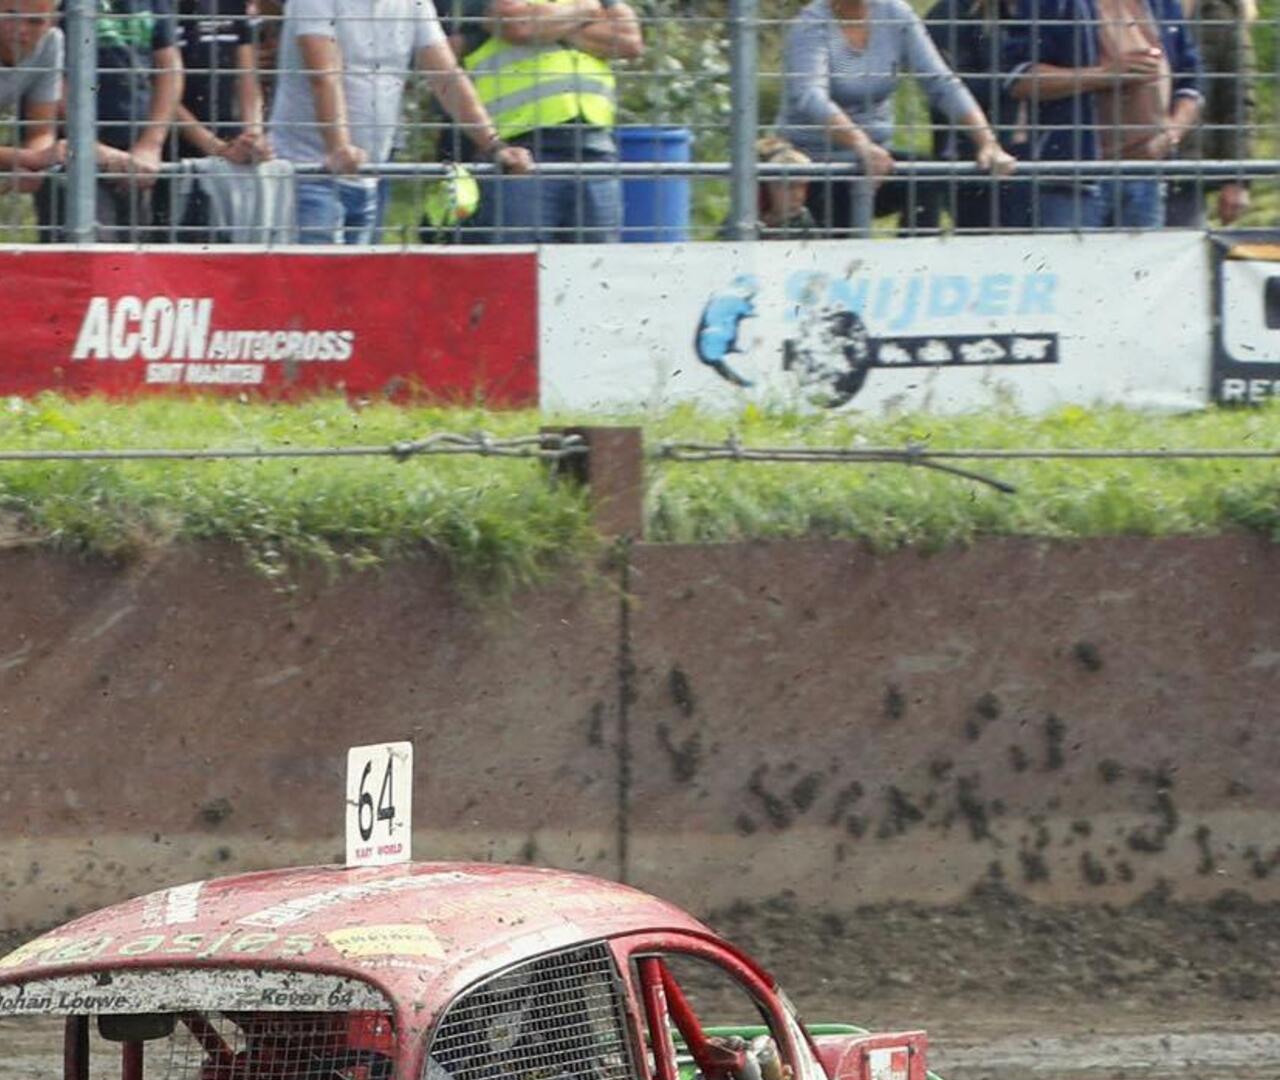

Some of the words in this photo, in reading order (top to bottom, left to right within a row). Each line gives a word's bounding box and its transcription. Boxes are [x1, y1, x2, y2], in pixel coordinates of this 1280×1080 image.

[72, 296, 213, 361] ACON
[208, 331, 354, 362] AUTOCROSS
[1222, 378, 1280, 403] RE
[358, 752, 395, 841] 64
[260, 988, 324, 1006] Kever
[327, 990, 354, 1007] 64
